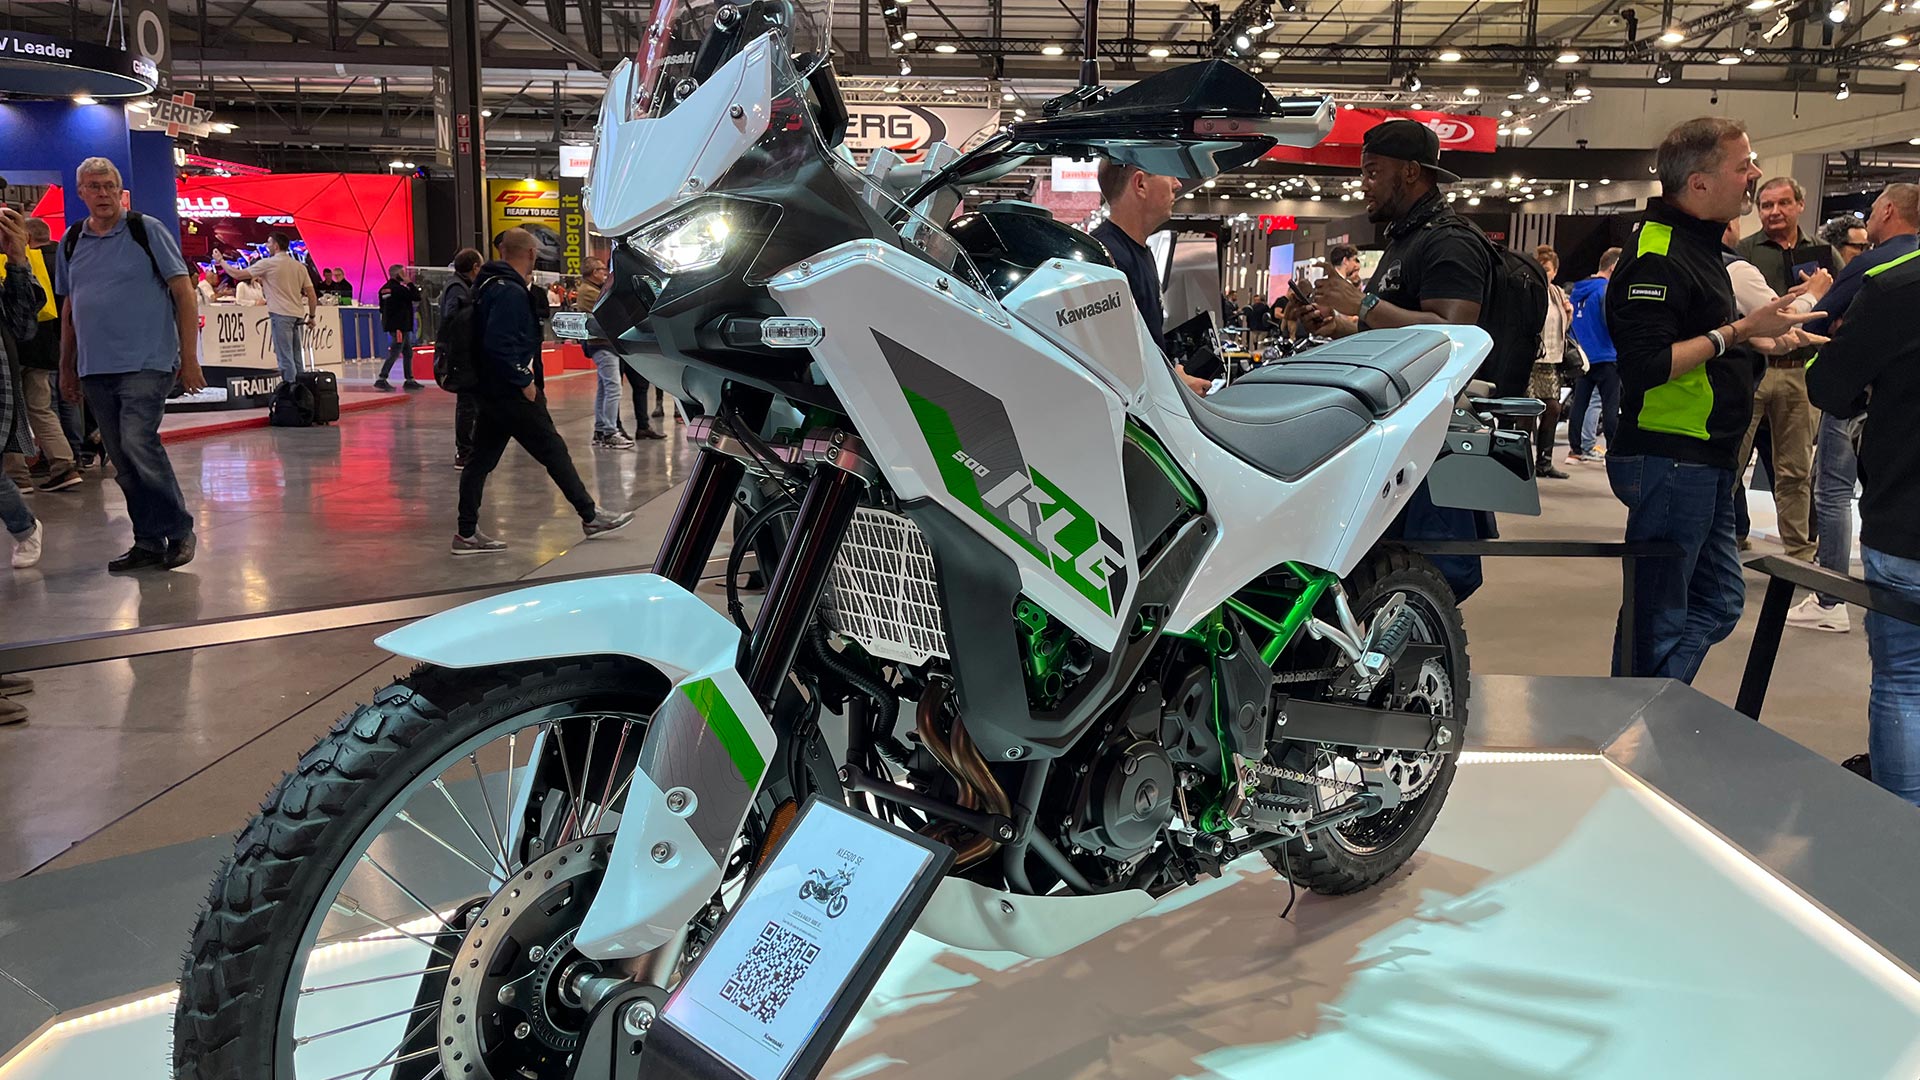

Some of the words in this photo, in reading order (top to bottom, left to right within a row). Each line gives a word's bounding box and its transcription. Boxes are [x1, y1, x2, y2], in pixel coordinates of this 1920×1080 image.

[13, 38, 73, 59] Leader
[150, 99, 213, 125] VERTEX
[437, 114, 449, 151] N
[506, 208, 529, 216] READY
[530, 208, 540, 216] TO
[540, 208, 559, 217] RACE
[562, 195, 583, 277] caberg.it
[1056, 292, 1121, 327] Kawasaki
[217, 313, 245, 342] 2025
[952, 450, 990, 477] 500
[982, 470, 1126, 590] KLE
[874, 644, 912, 660] Kawasaki
